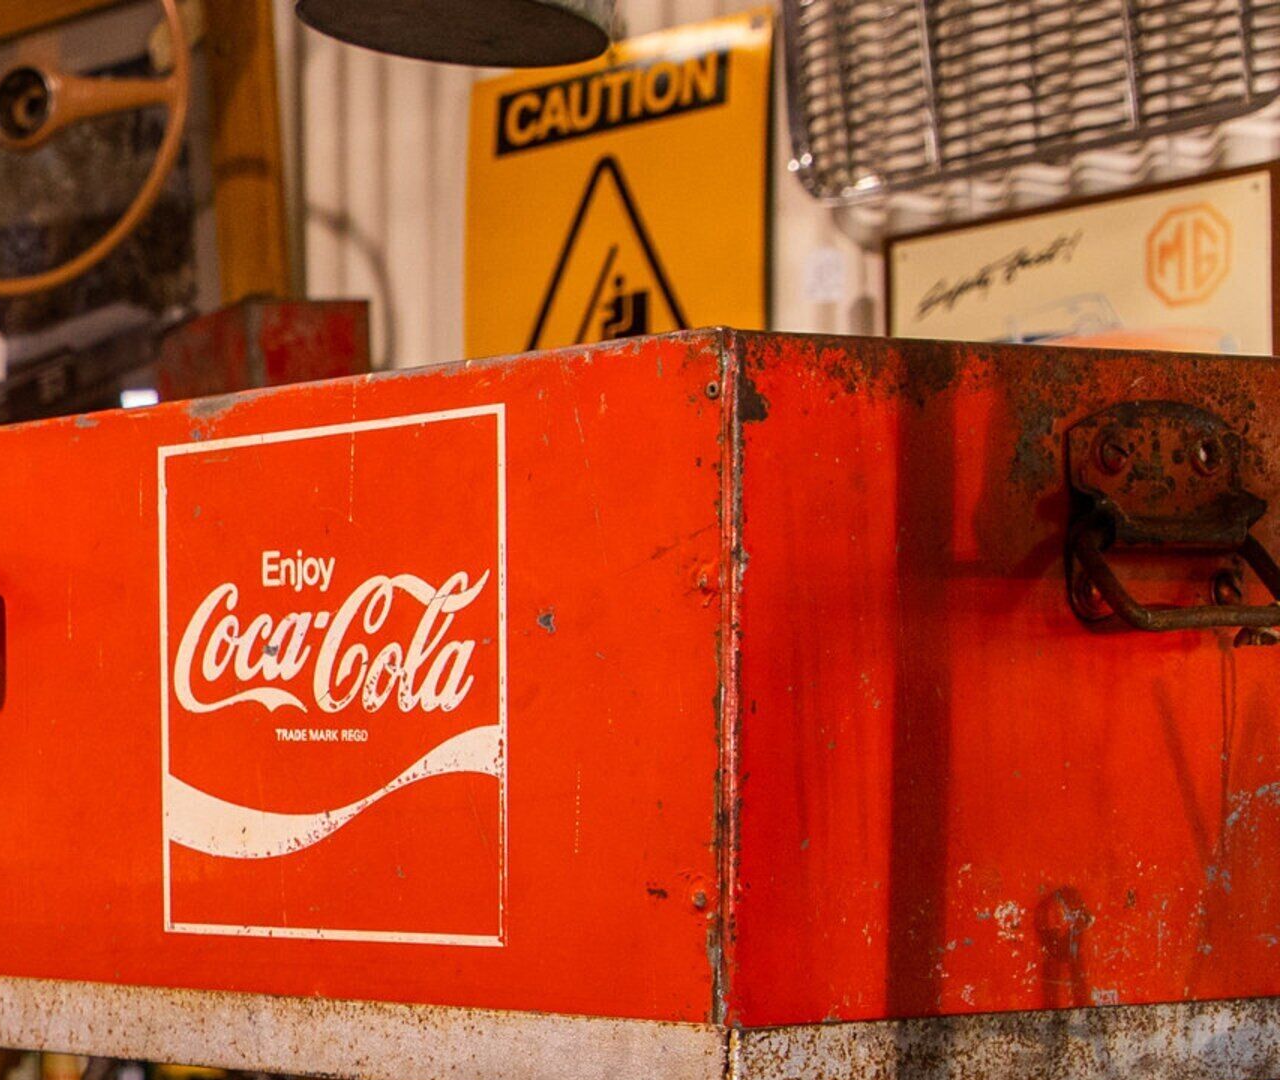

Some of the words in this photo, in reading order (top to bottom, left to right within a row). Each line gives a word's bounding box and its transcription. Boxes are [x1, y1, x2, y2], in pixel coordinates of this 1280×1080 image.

[504, 50, 720, 148] CAUTION
[262, 550, 335, 591] Enjoy
[174, 568, 490, 713] Coca-Cola
[275, 728, 307, 742] TRADE
[308, 728, 339, 742] MARK
